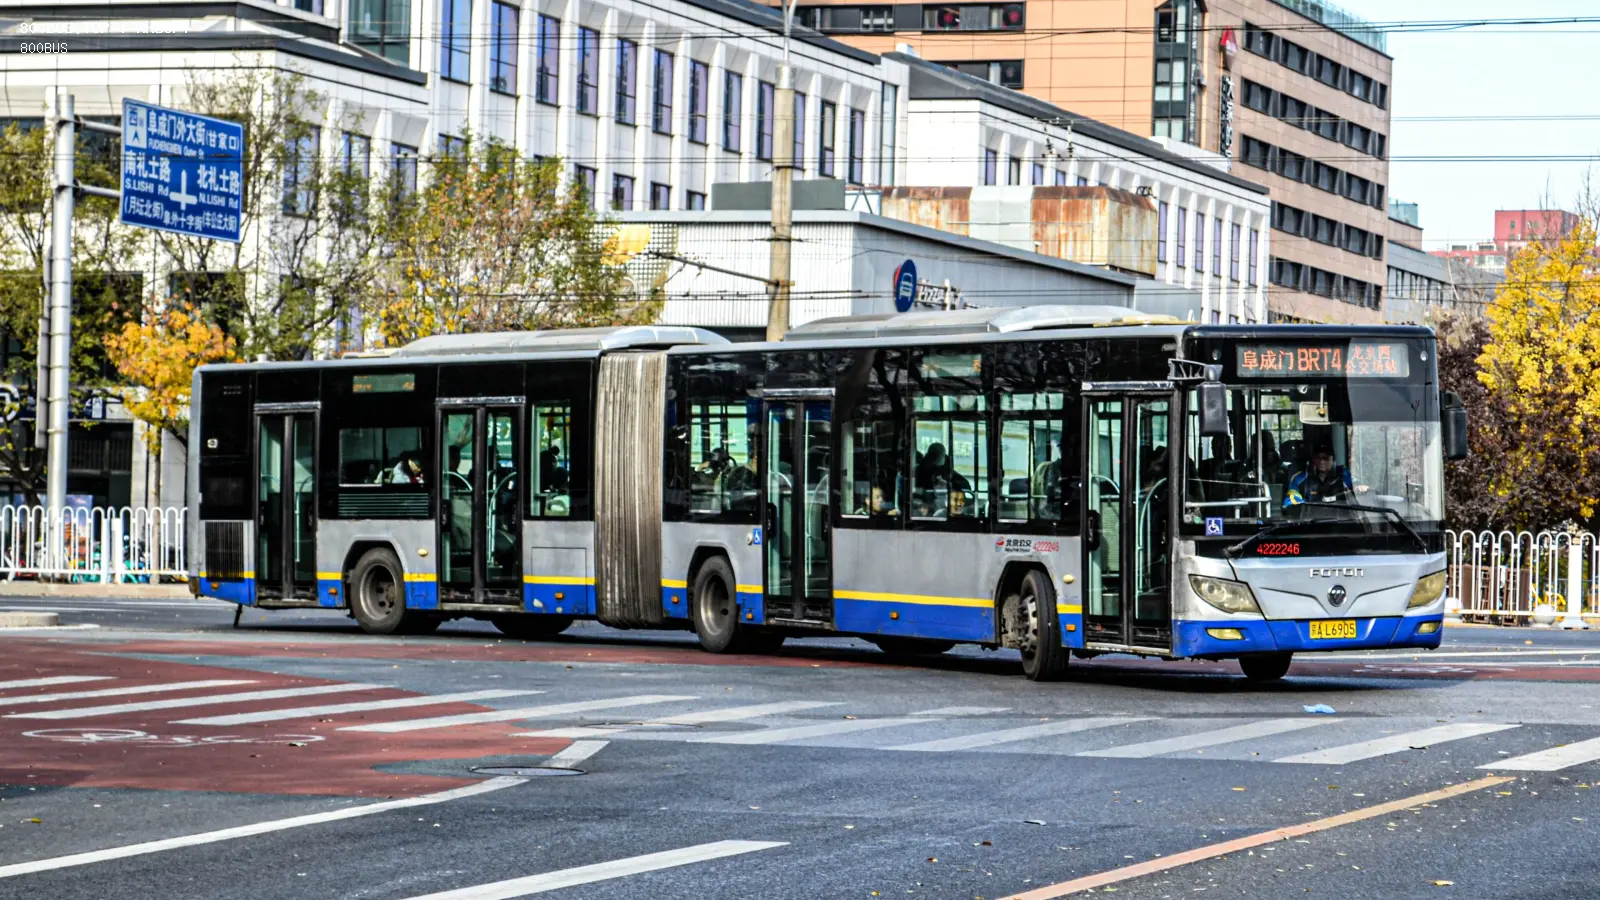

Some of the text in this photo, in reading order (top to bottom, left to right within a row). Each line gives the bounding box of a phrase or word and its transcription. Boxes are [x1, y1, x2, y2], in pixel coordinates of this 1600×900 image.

[125, 149, 171, 183] 南礼士路
[196, 164, 240, 196] 北礼士路
[158, 184, 169, 197] Rd
[228, 197, 239, 209] Rd
[1242, 348, 1341, 371] 阜成门 BRT4
[1257, 543, 1300, 555] 4222246
